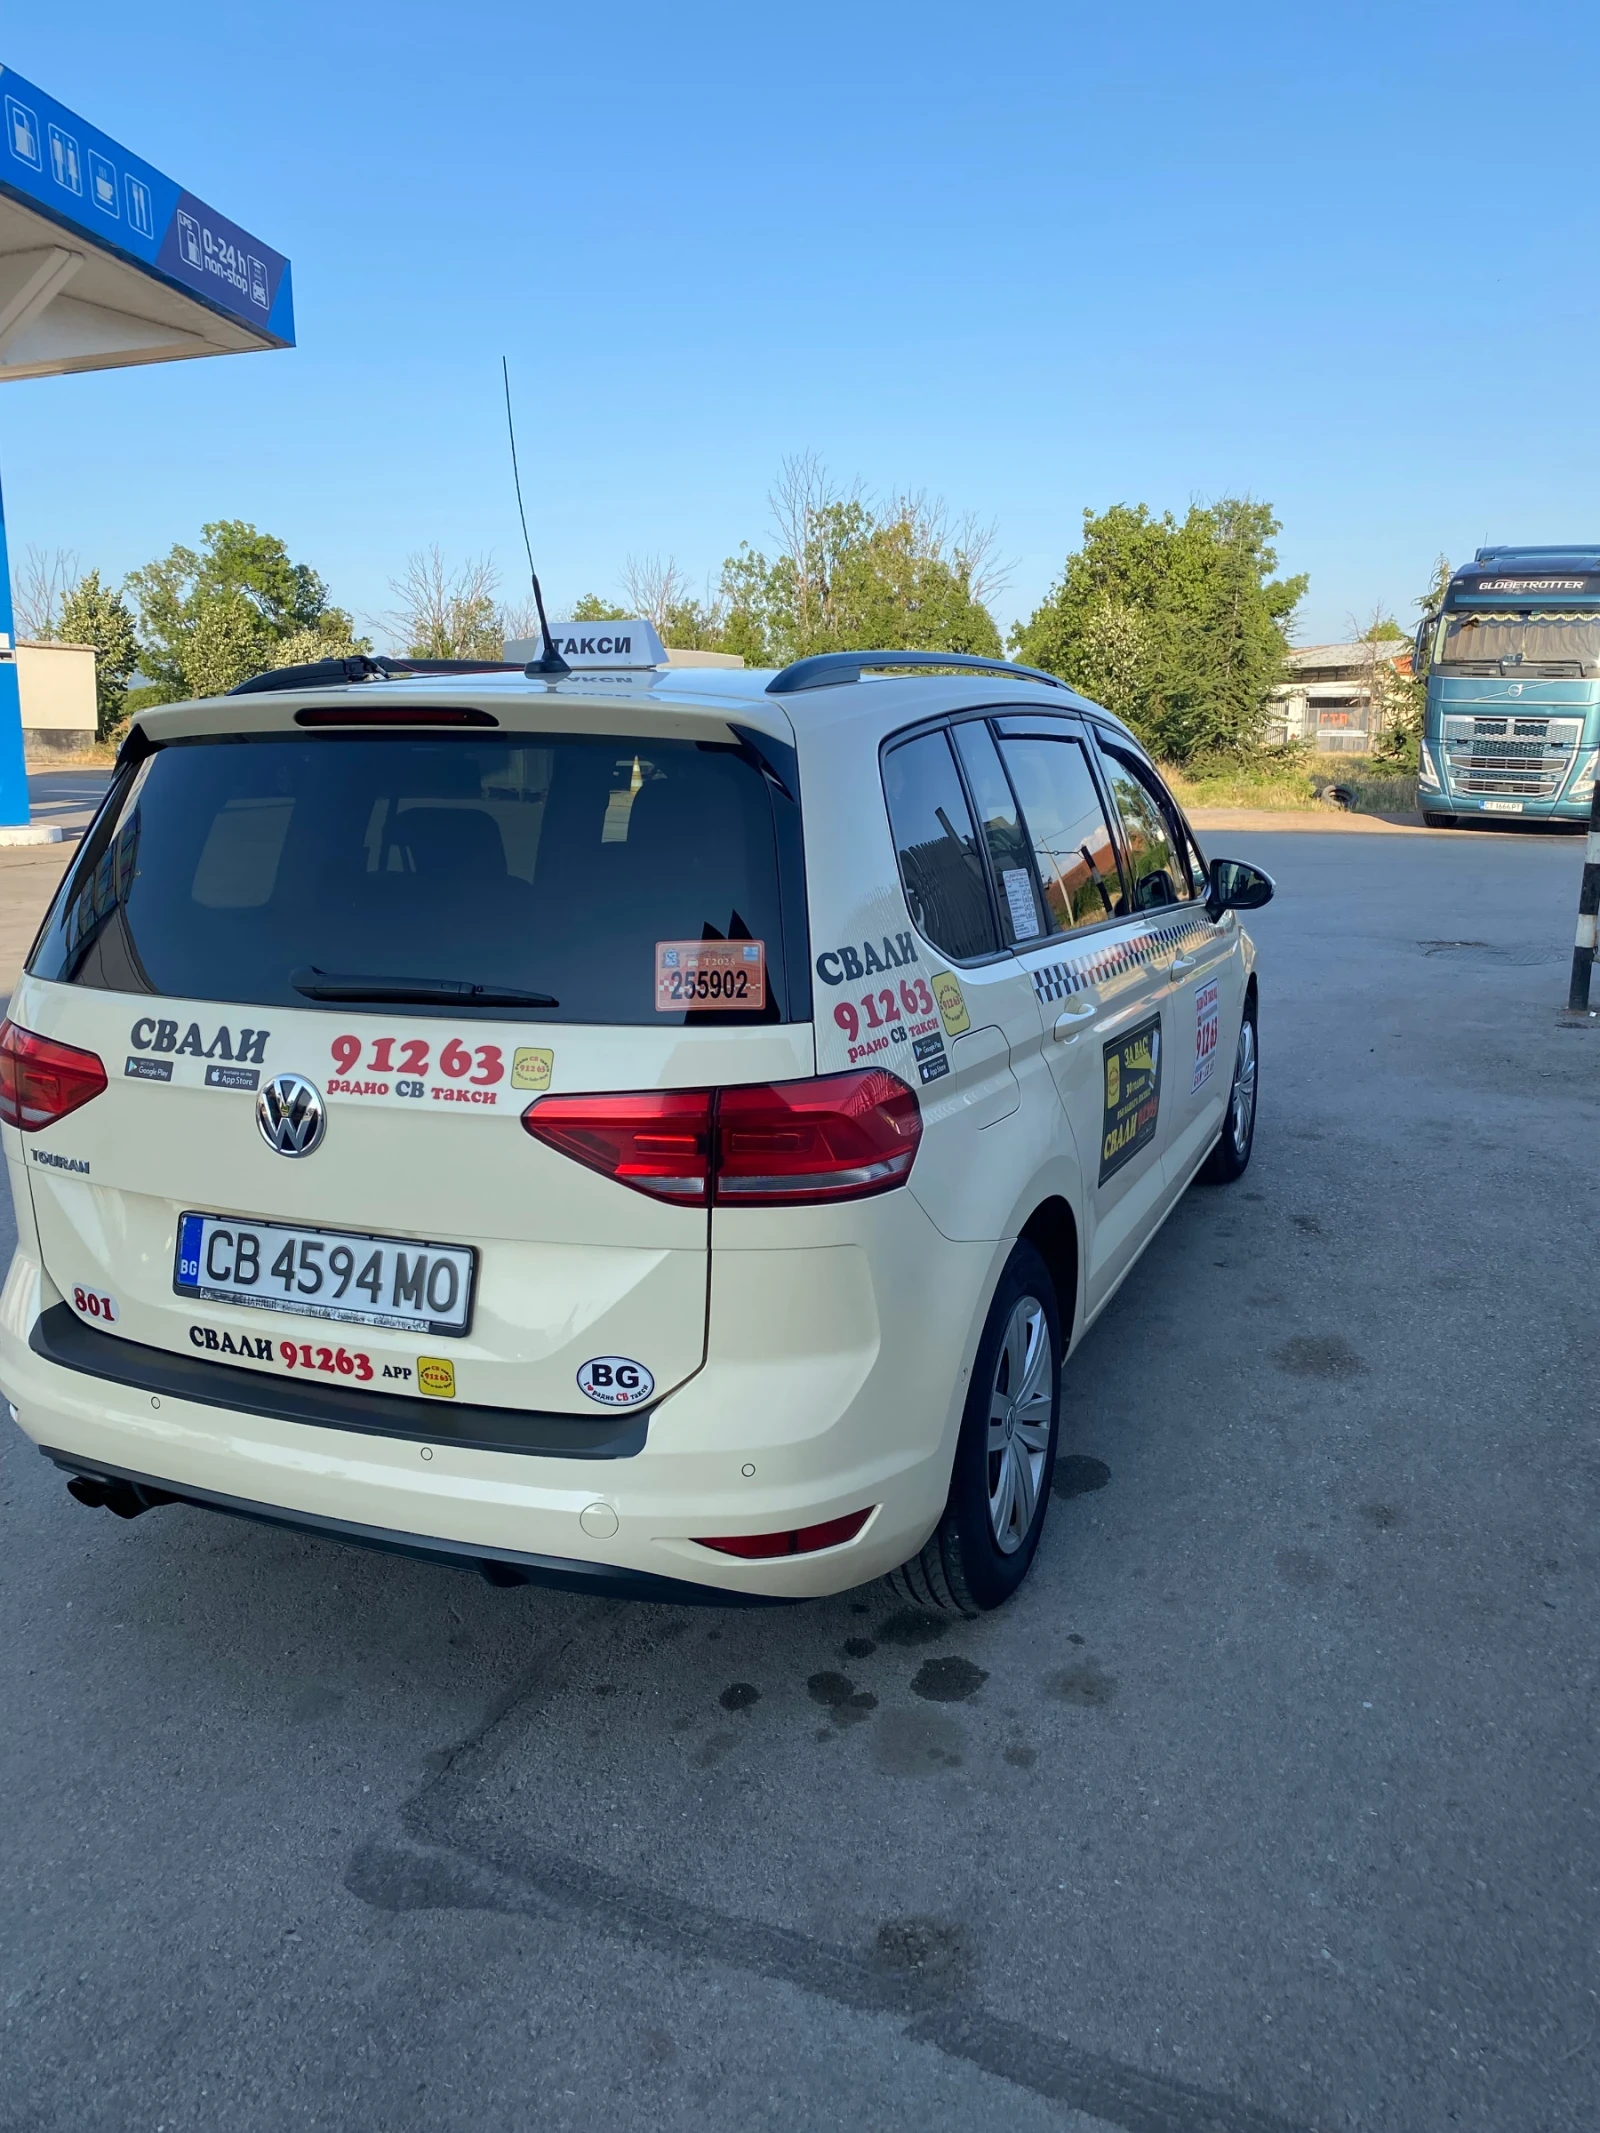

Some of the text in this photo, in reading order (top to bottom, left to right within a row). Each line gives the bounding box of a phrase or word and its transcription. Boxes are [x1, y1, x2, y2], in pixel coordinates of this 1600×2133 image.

[204, 255, 248, 294] non-stop
[1479, 580, 1584, 590] GLOBETROTTER
[551, 637, 632, 654] ТАКСИ
[816, 932, 918, 986] СВАЛИ
[671, 970, 748, 1000] 255902
[131, 1017, 271, 1064] СВАЛИ
[848, 1018, 939, 1063] радио СВ такси
[139, 1066, 168, 1078] Google Play
[222, 1075, 253, 1086] App Store
[327, 1079, 497, 1104] радио СВ такси
[1104, 1112, 1138, 1160] СВАЛИ
[31, 1148, 90, 1174] TOURAN
[180, 1258, 197, 1276] BG
[74, 1287, 115, 1322] 801
[189, 1325, 274, 1361] СВАЛИ
[280, 1341, 374, 1381] 91263
[592, 1364, 639, 1388] BG
[592, 1390, 614, 1401] радио
[630, 1384, 648, 1400] такси
